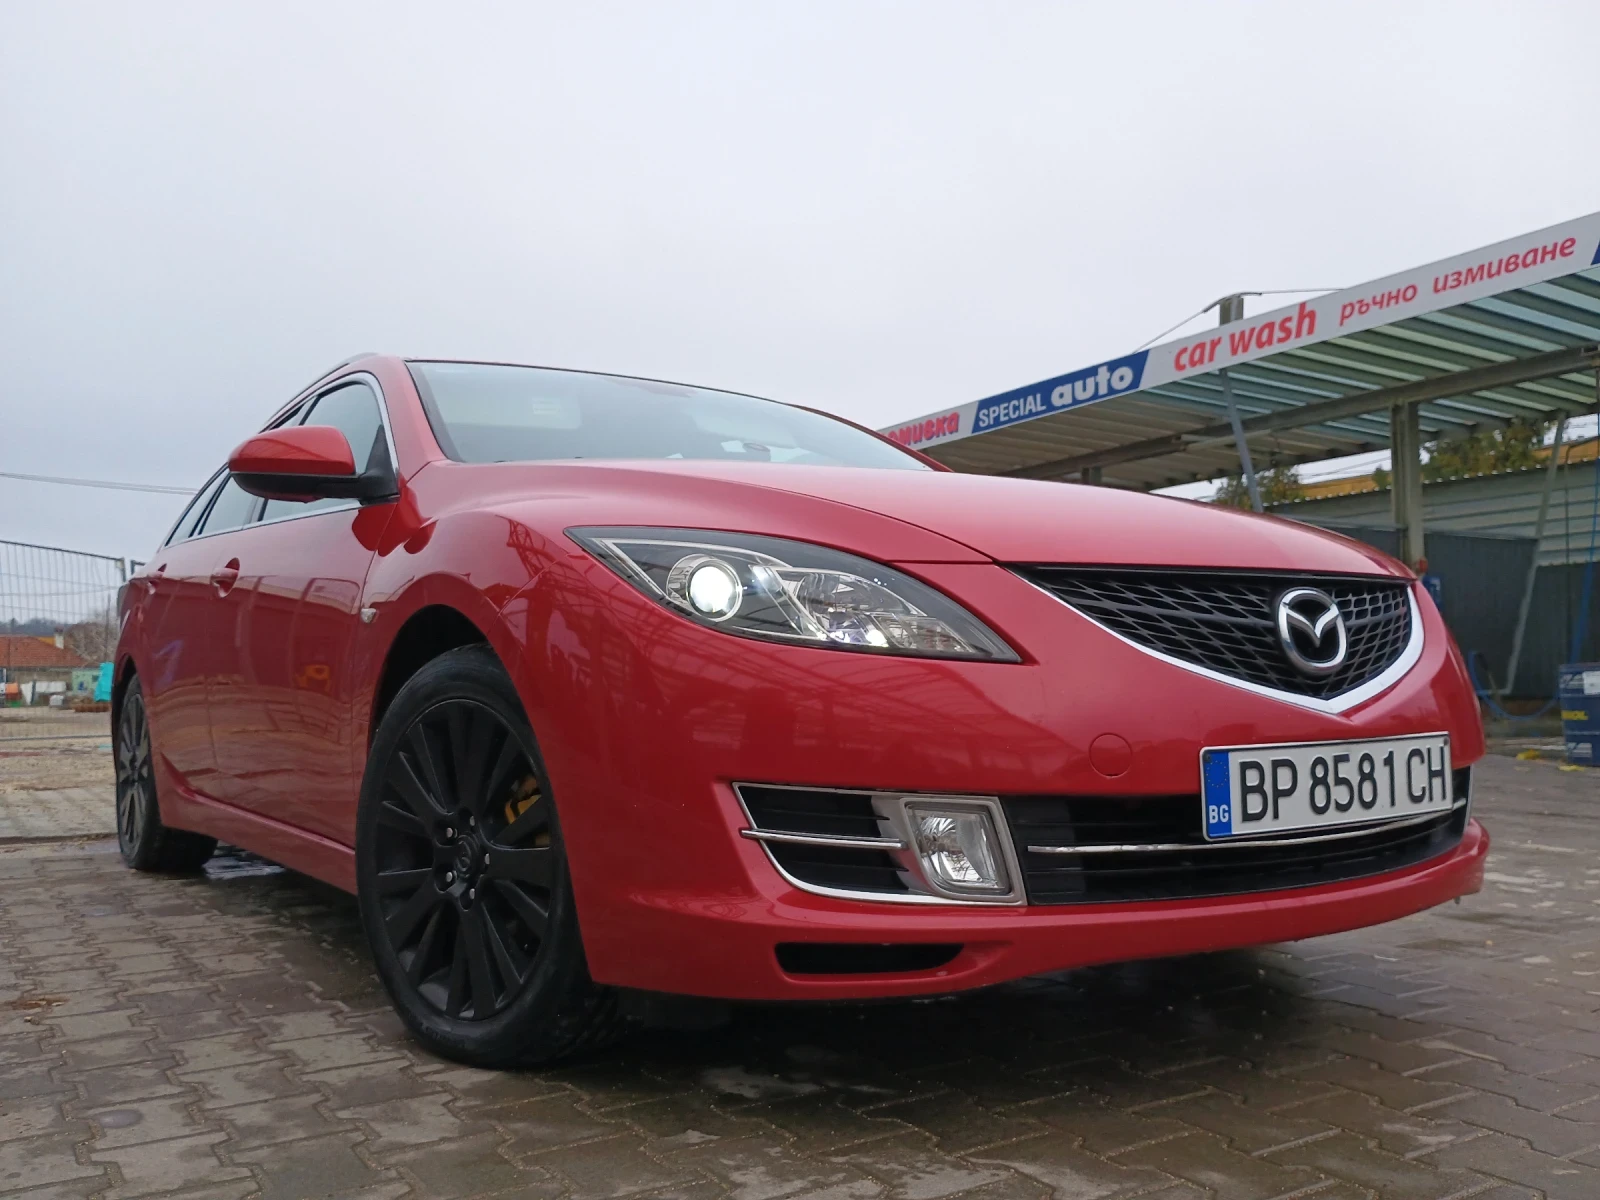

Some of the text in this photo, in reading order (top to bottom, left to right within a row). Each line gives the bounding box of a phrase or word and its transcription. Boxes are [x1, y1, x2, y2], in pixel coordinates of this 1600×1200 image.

[1339, 237, 1576, 327] ръчно измиване
[1174, 301, 1317, 372] car wash
[978, 365, 1134, 428] SPECIAL auto
[1209, 804, 1229, 824] BG
[1239, 745, 1447, 823] BP 8581 CH
